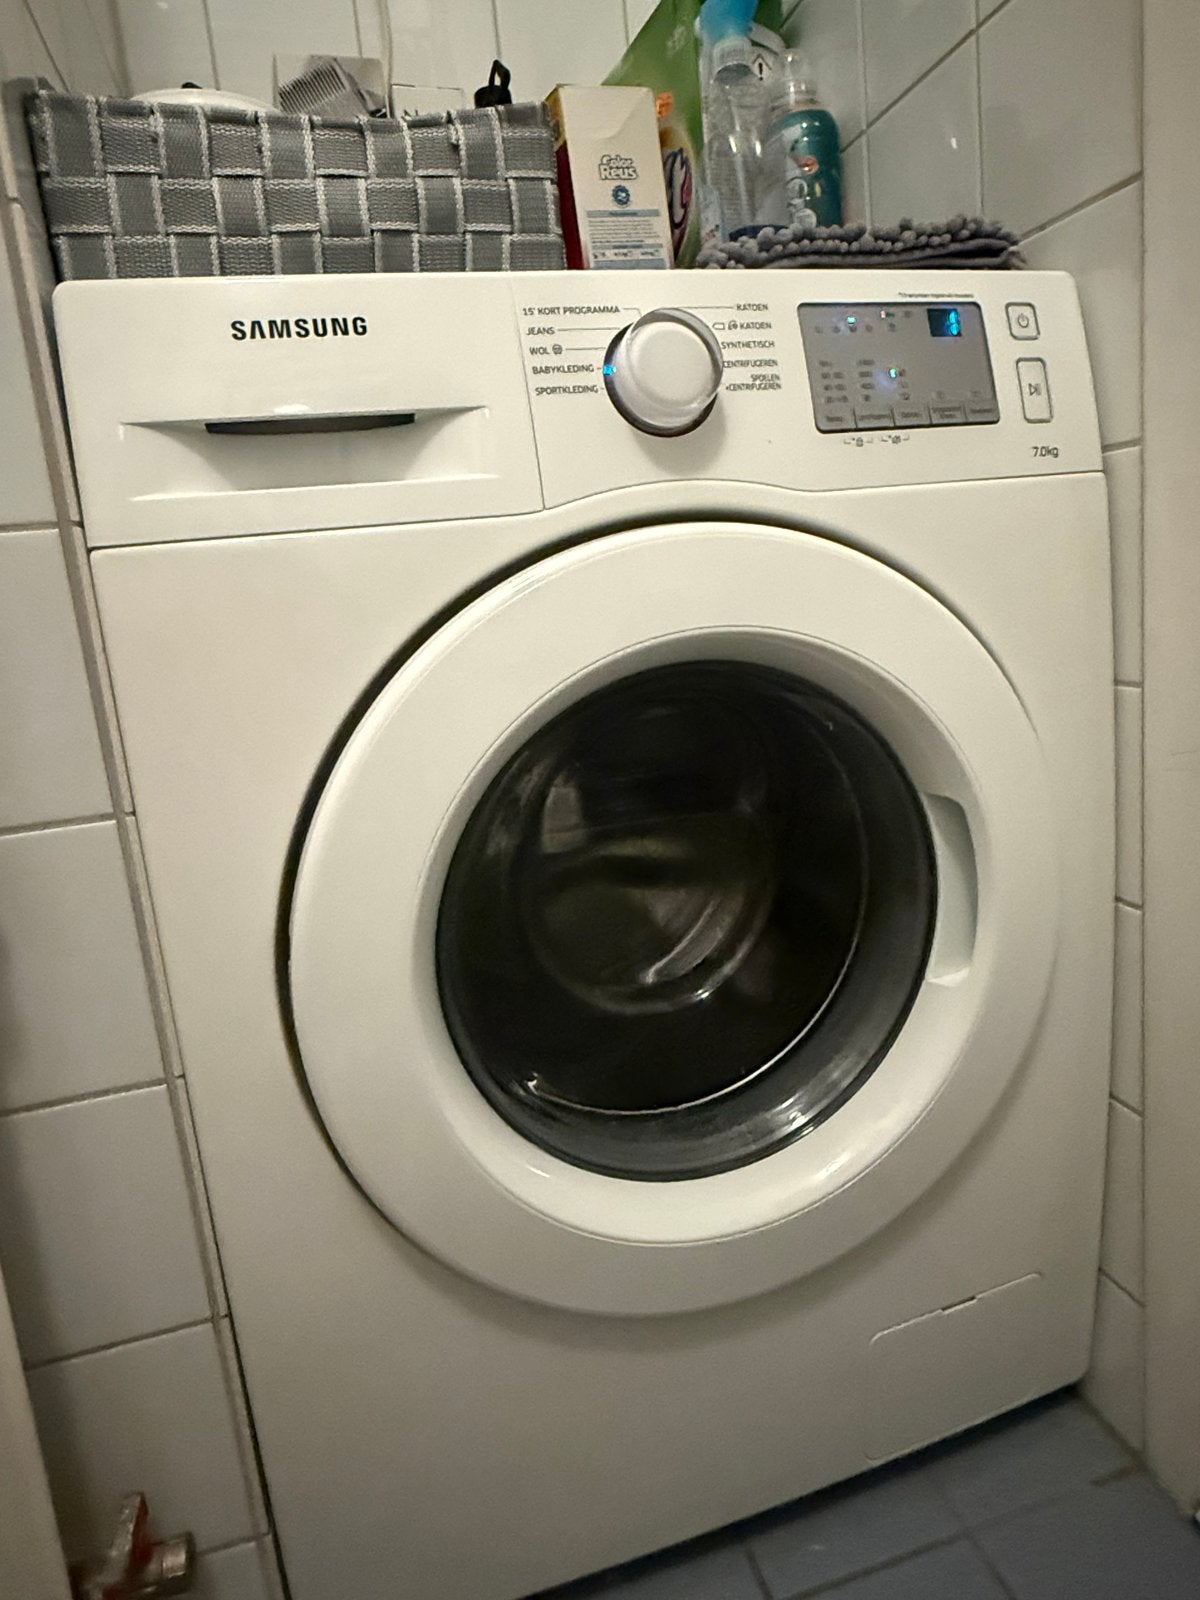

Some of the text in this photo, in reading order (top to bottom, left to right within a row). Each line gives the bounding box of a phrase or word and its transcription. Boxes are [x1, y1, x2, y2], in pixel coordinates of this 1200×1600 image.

[601, 154, 633, 168] Color
[599, 164, 638, 180] Reus
[538, 306, 560, 315] KORT
[563, 305, 621, 315] PROGRAMMA
[736, 303, 769, 312] KATOEN
[230, 316, 368, 341] SAMSUNG
[526, 326, 556, 336] JEANS
[740, 321, 772, 331] KATOEN
[721, 340, 775, 350] SYNTHETISCH
[529, 346, 551, 356] WOL
[532, 363, 595, 375] BABYKLEDING
[535, 384, 599, 396] SPORTKLEDING
[1031, 446, 1060, 459] 7.0kg
